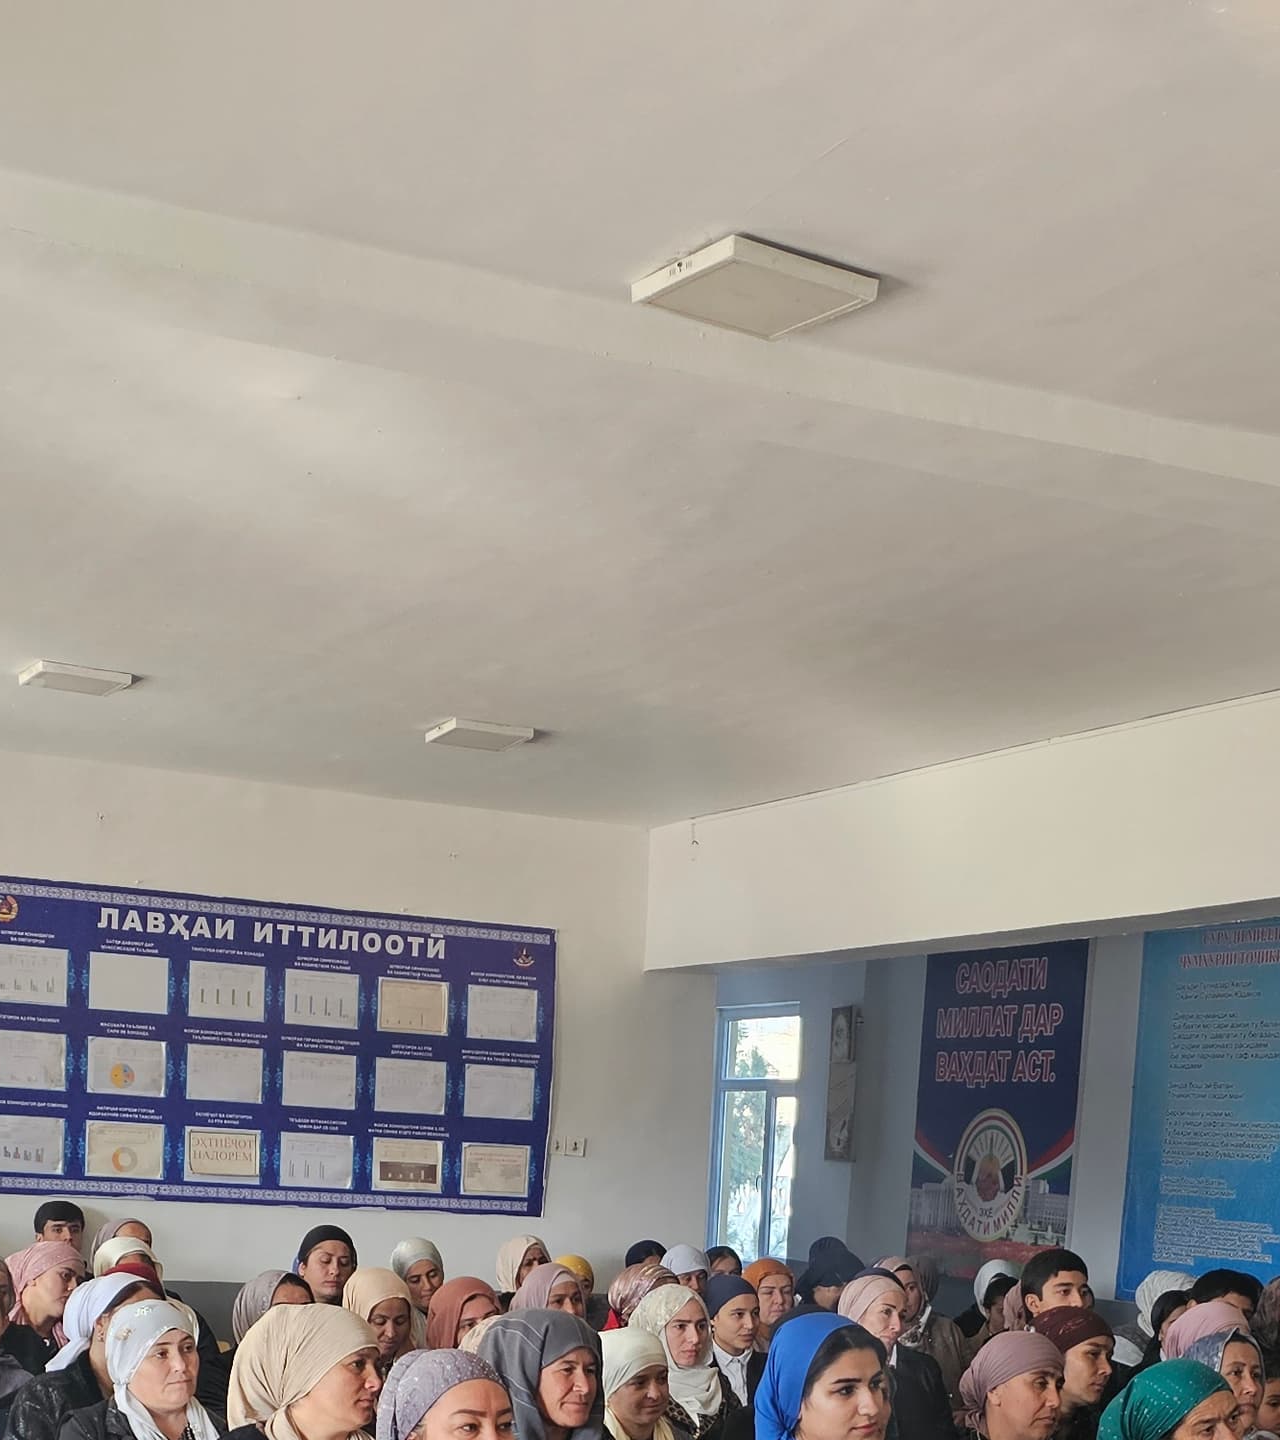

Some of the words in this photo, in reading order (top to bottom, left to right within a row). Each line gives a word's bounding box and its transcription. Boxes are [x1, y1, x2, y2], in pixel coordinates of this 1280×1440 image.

[97, 907, 235, 941] ЛАВҲАИ
[253, 921, 446, 960] ИТТИЛООТӢ
[956, 957, 1048, 998] САОДАТИ
[936, 1005, 1017, 1038] МИЛЛАТ
[1018, 1003, 1064, 1043] ДАР
[936, 1050, 1011, 1088] ВАҲДАТ
[1012, 1050, 1056, 1082] АСТ.
